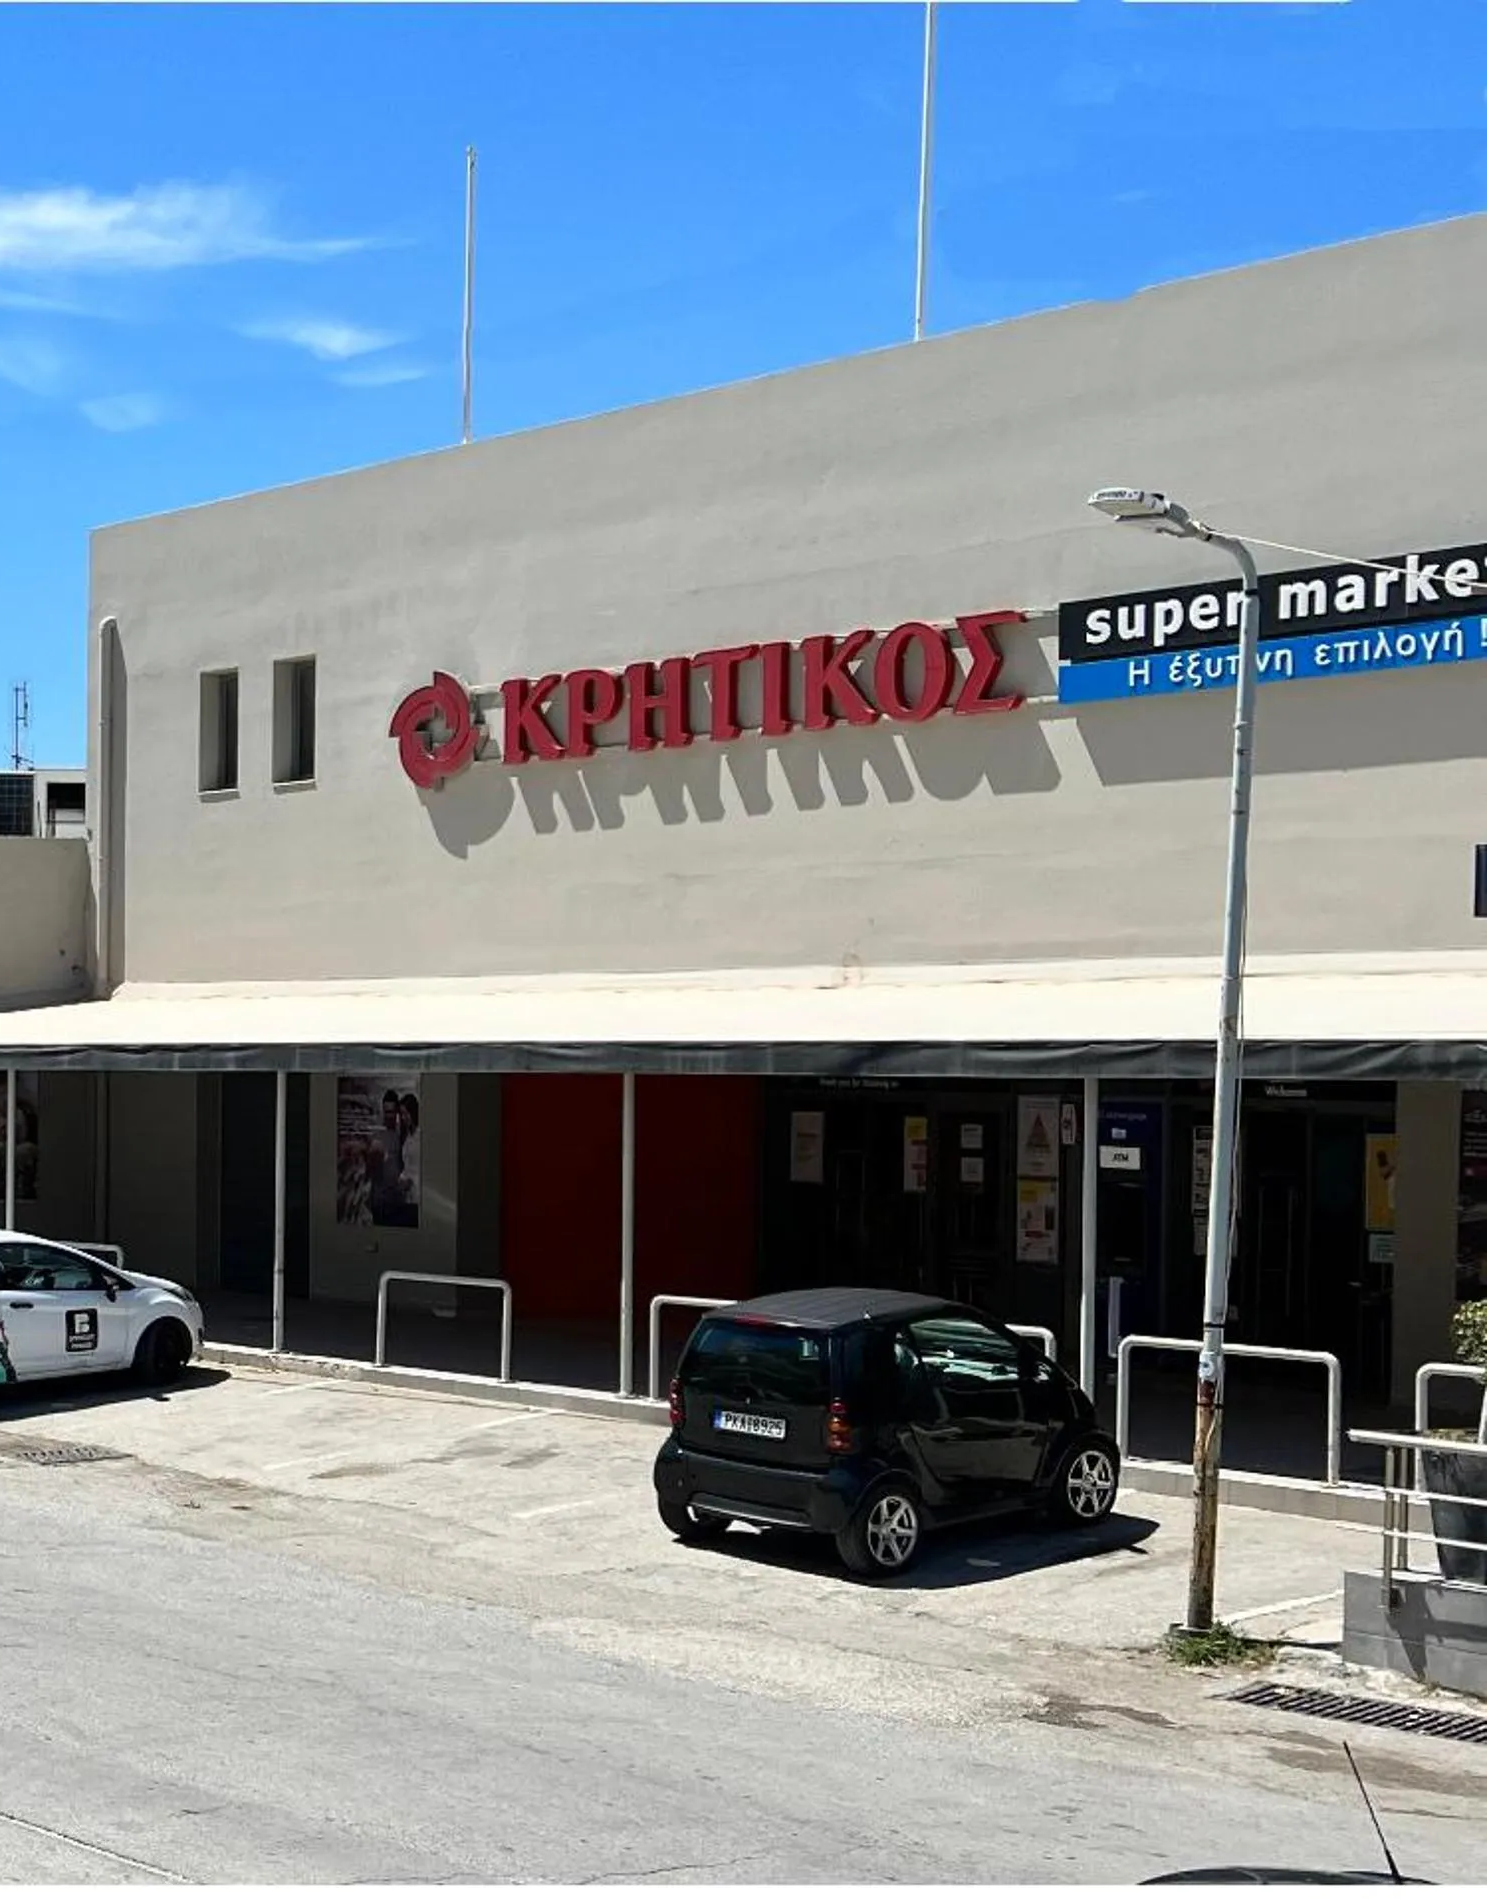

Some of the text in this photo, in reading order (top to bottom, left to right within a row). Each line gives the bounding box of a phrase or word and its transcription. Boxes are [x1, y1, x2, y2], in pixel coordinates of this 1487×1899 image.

[1085, 555, 1487, 648] super marke
[501, 610, 1029, 766] ΚΡΗΤΙΚΟΣ
[1128, 659, 1151, 687] Η
[1314, 621, 1464, 666] επιλογή
